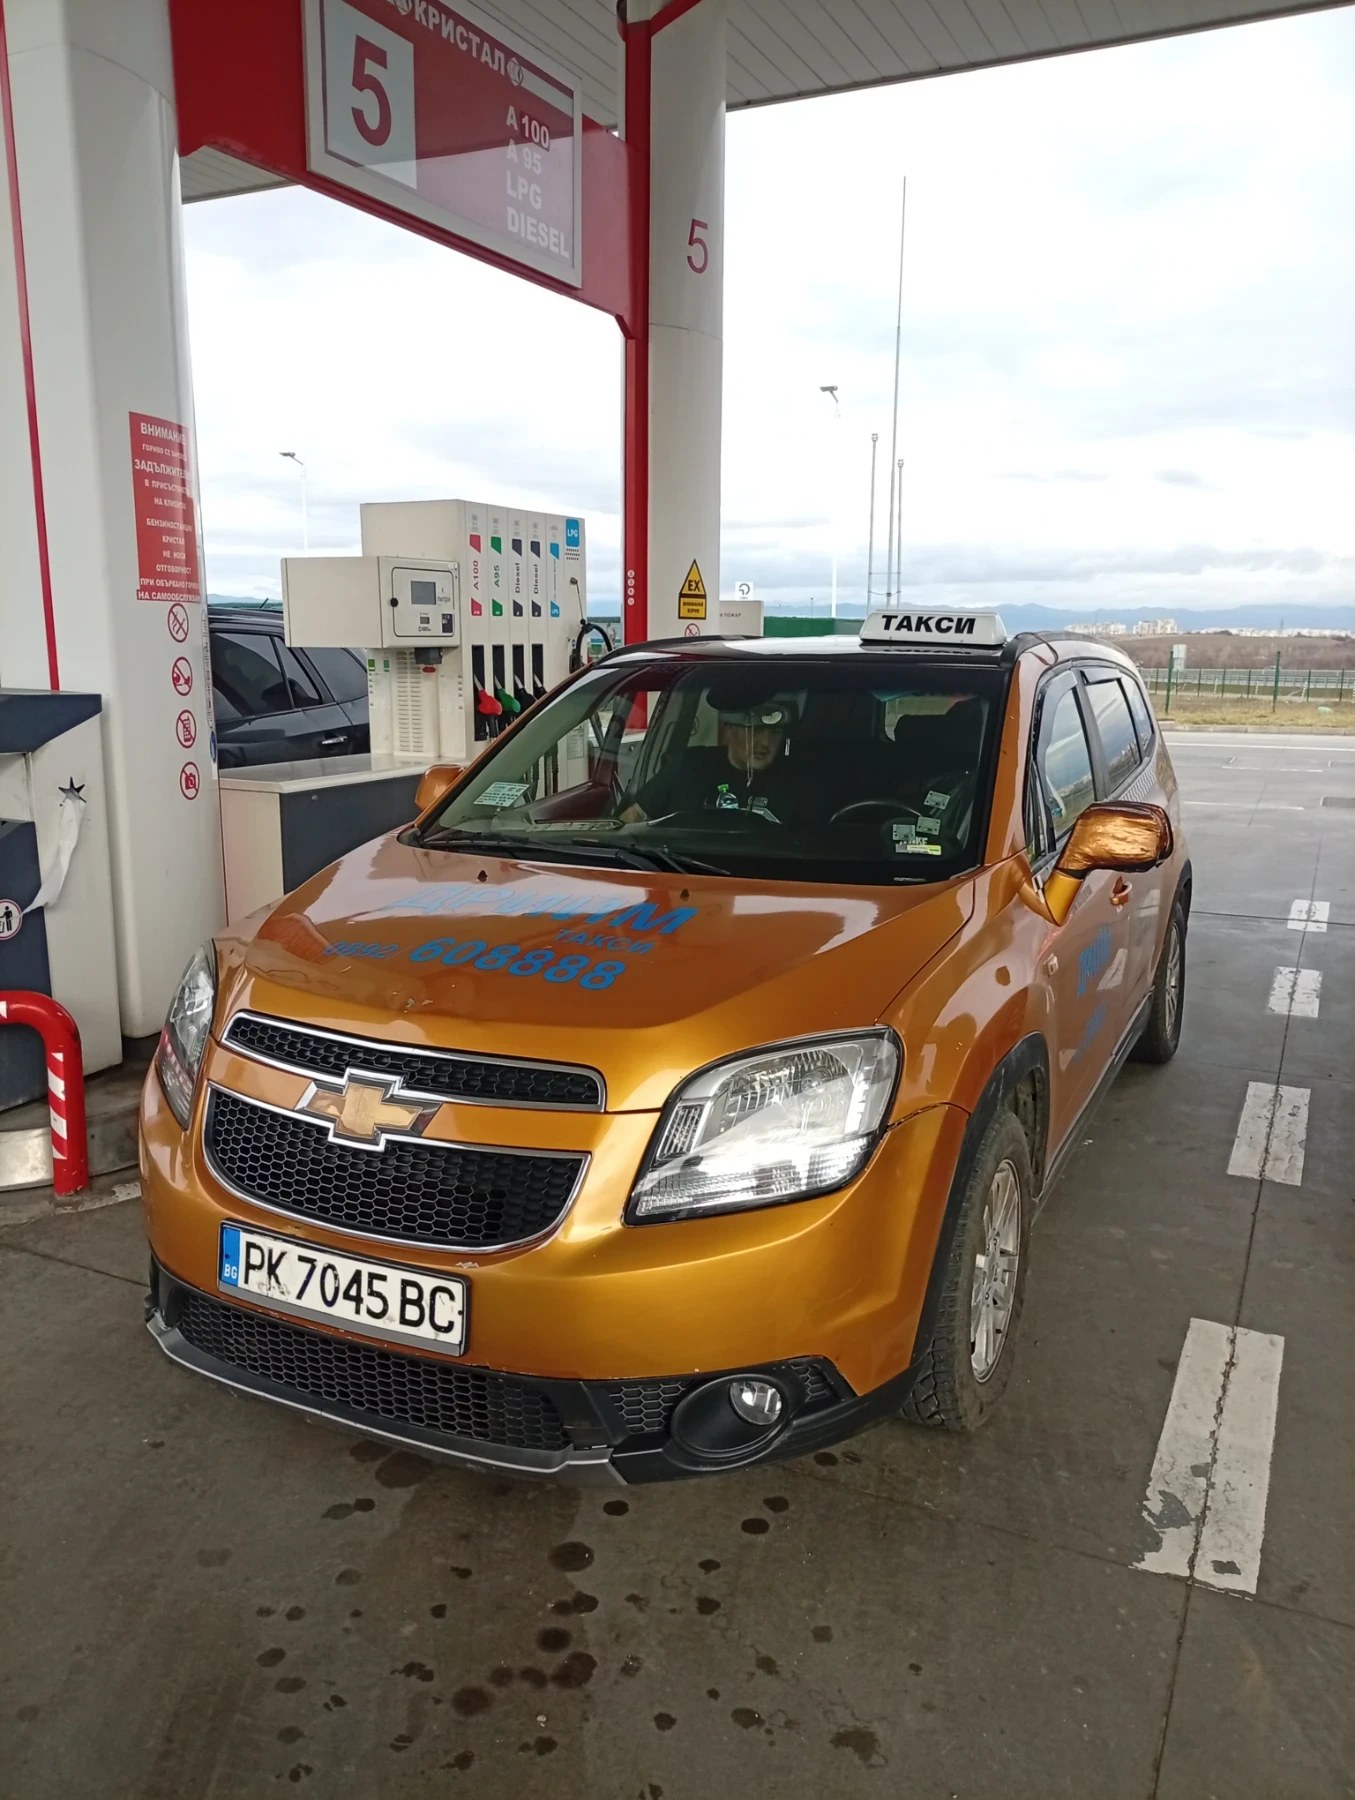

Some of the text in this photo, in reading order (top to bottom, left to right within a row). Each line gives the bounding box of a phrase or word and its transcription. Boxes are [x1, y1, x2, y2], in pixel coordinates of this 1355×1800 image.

[414, 1, 505, 76] КРИСТАЛ
[351, 34, 392, 146] 5
[521, 115, 549, 149] 100
[522, 147, 541, 174] 95
[506, 170, 542, 210] LPG
[507, 206, 569, 259] DIESEL
[687, 218, 709, 274] 5
[567, 529, 578, 537] LPG
[138, 591, 150, 600] НА
[140, 577, 155, 586] ПРИ
[688, 580, 700, 592] EX
[882, 615, 976, 634] ТАКСИ
[554, 929, 654, 954] ТАКСИ
[409, 937, 626, 990] 608888
[224, 1264, 238, 1279] BG
[244, 1240, 456, 1333] PK 7045 BC
